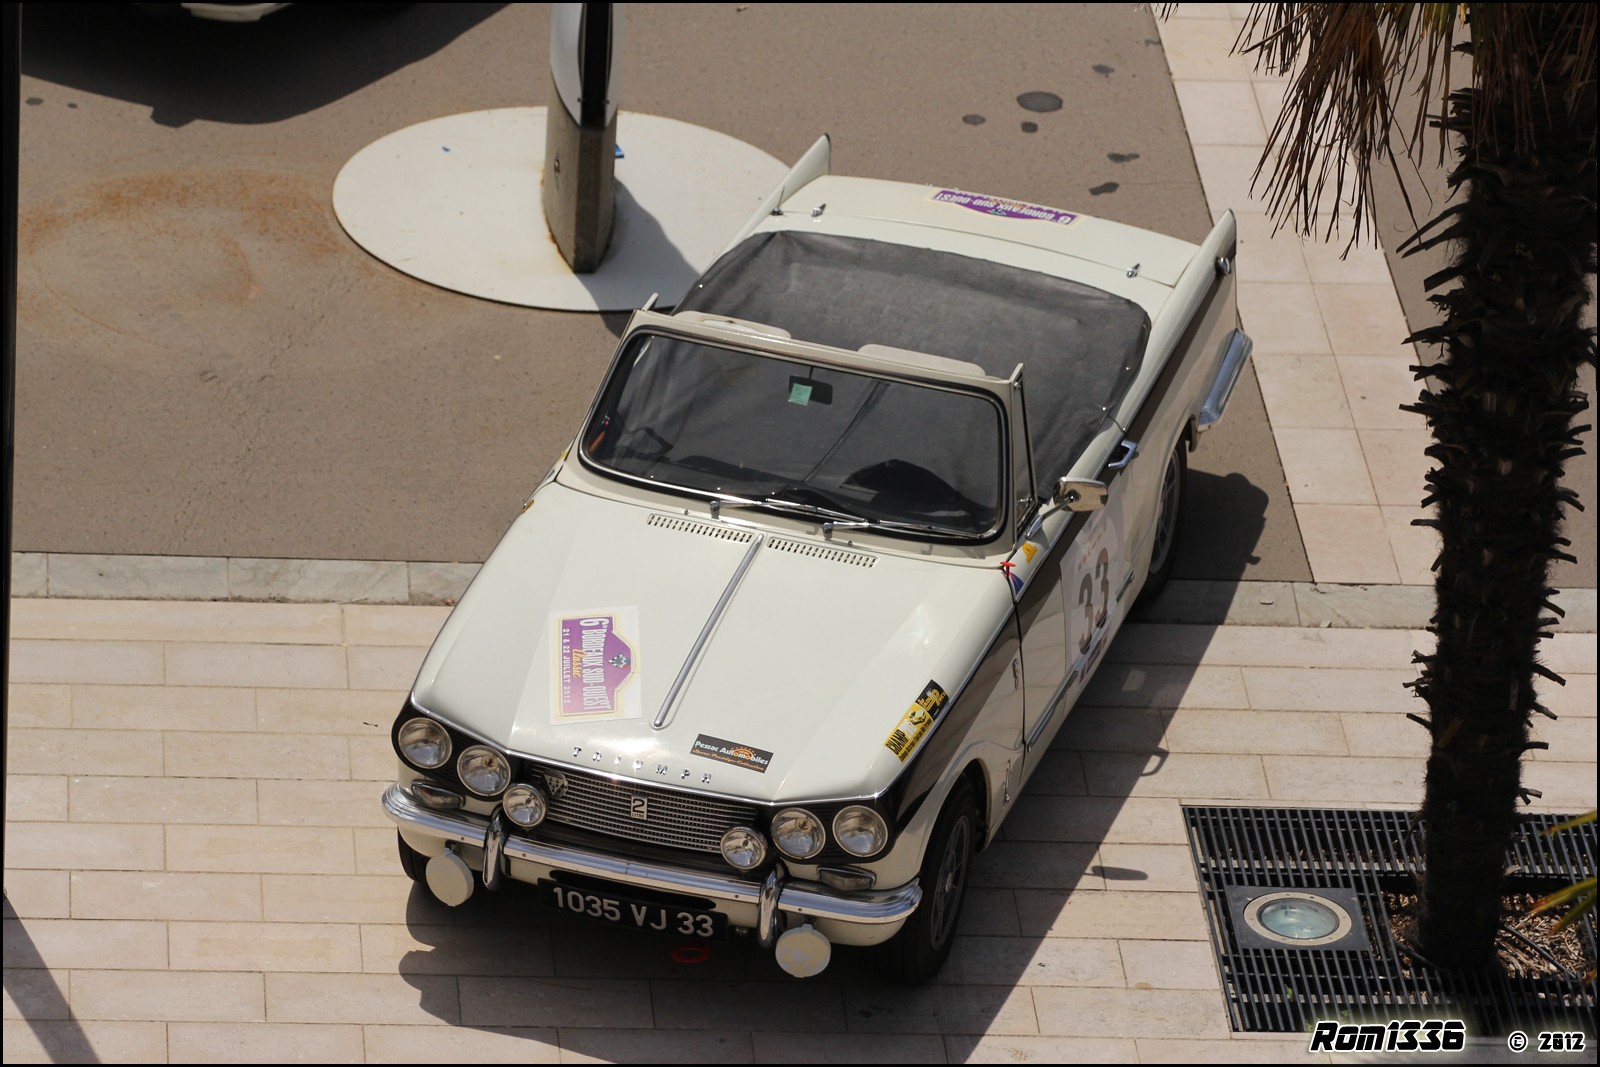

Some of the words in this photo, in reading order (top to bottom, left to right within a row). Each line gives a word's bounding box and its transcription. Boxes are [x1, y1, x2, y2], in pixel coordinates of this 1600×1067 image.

[998, 205, 1055, 220] BORDEAUX
[562, 628, 571, 637] 21
[562, 645, 571, 655] 22
[581, 628, 608, 668] BORDEAUX
[562, 656, 571, 684] JUILLET
[571, 648, 586, 679] Classic
[562, 685, 571, 705] 2012
[694, 740, 719, 752] Pessac
[719, 746, 769, 765] Automobiles
[573, 746, 713, 785] TRIUMPH
[632, 798, 645, 814] 2
[553, 887, 621, 922] 1035
[630, 903, 667, 931] VJ
[676, 912, 714, 938] 33
